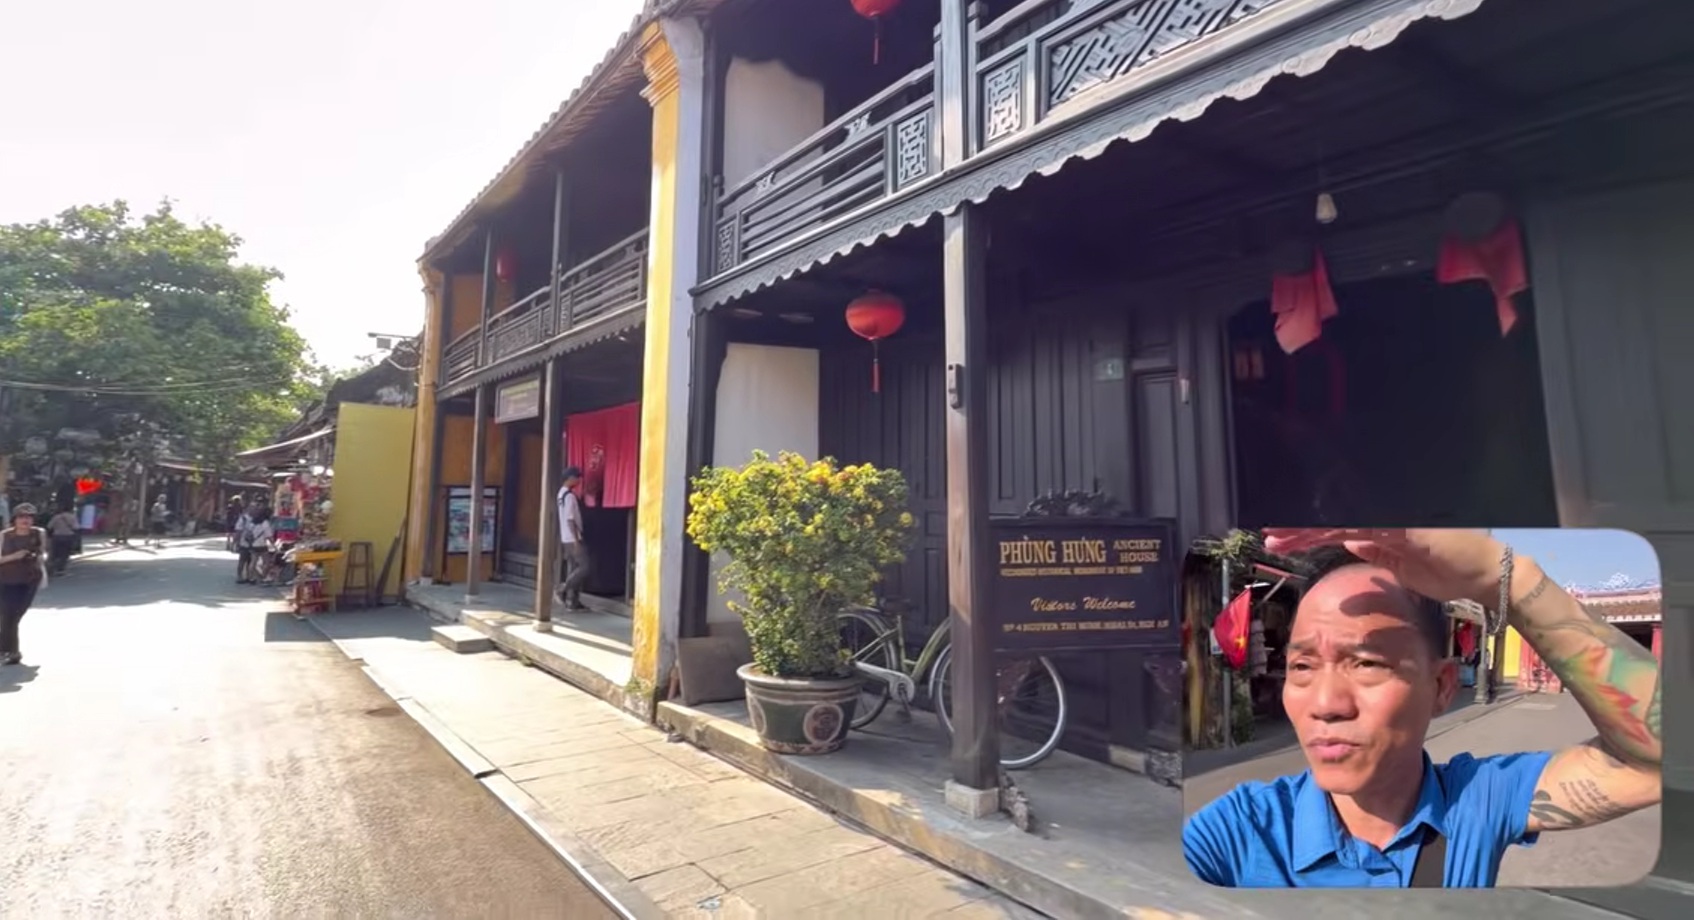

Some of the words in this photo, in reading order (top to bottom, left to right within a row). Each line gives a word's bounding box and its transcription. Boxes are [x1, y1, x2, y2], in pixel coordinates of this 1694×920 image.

[1000, 535, 1057, 564] PHÙNG
[1113, 539, 1162, 550] ANCIENT
[1120, 552, 1159, 563] HOUSE
[1083, 596, 1137, 610] Welcome
